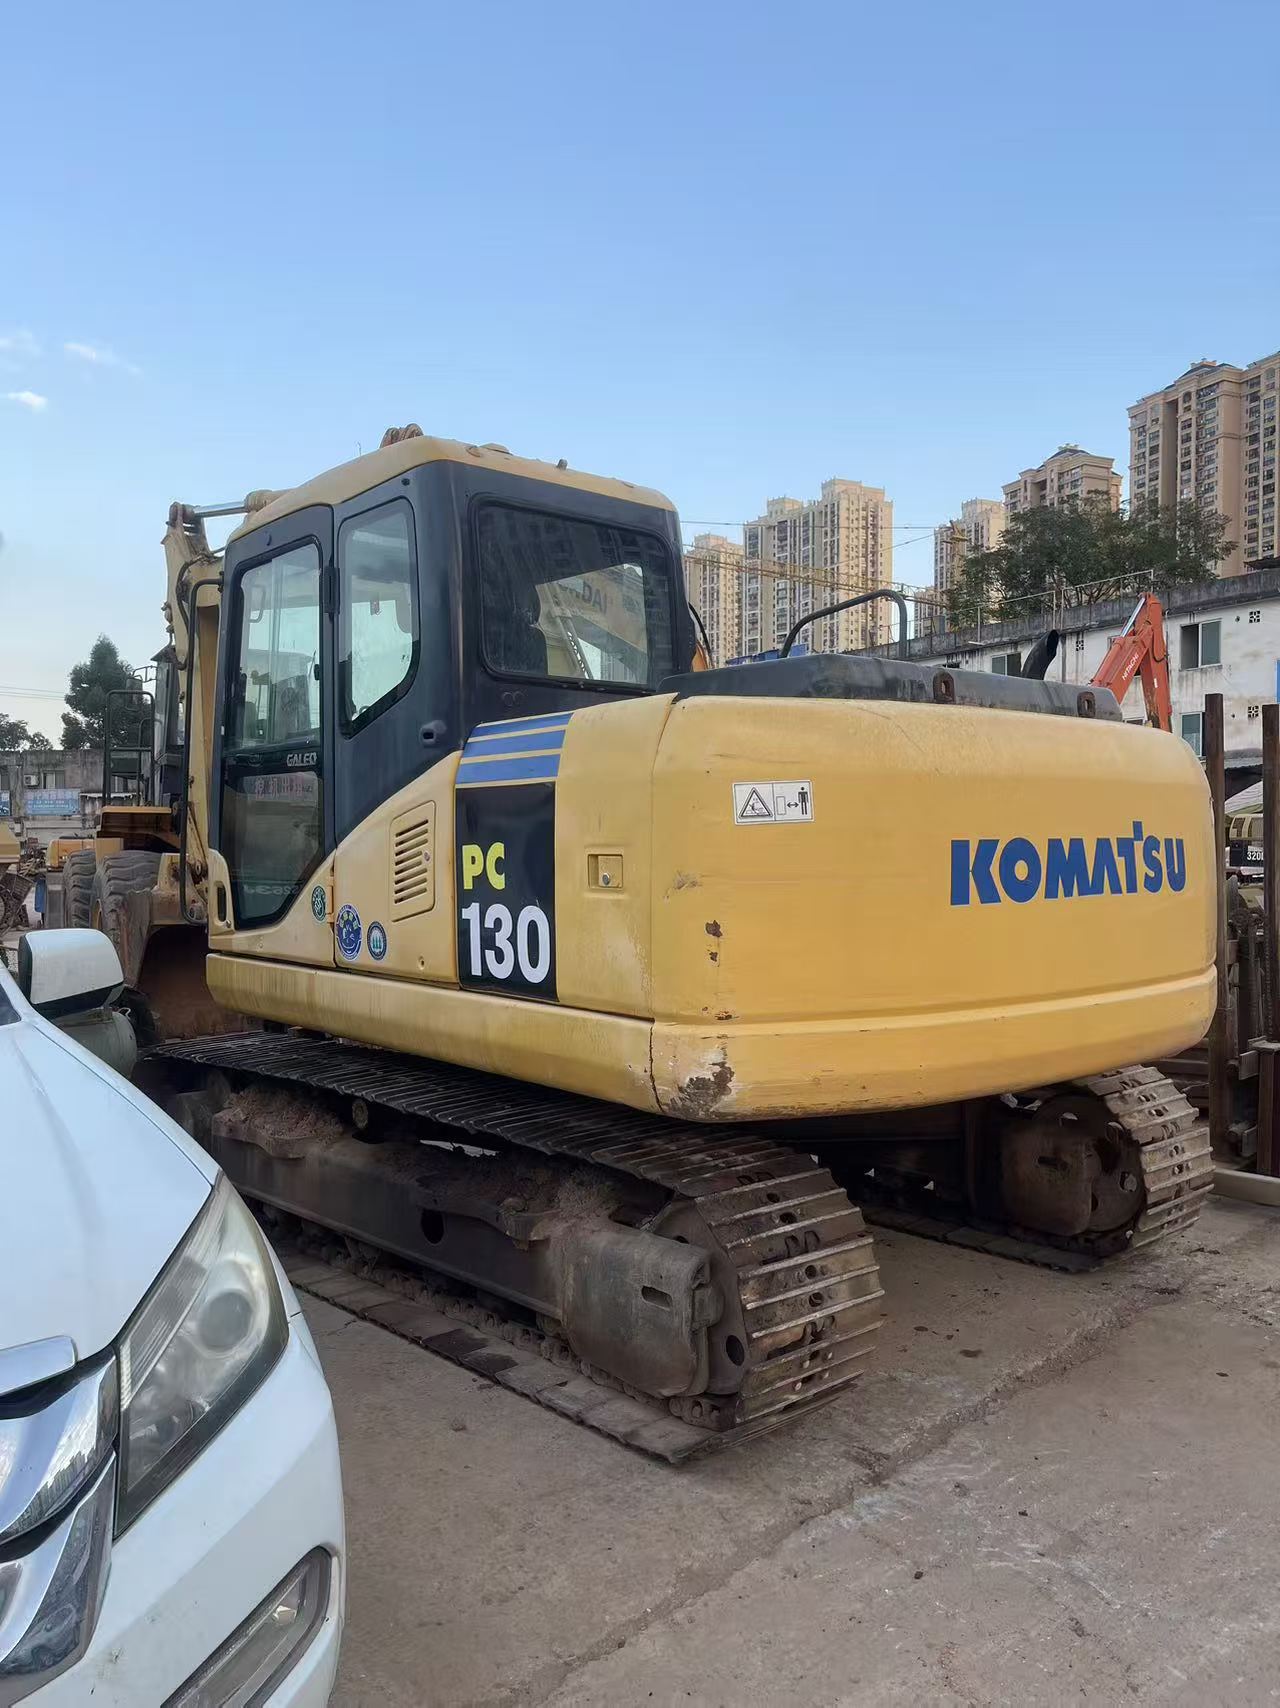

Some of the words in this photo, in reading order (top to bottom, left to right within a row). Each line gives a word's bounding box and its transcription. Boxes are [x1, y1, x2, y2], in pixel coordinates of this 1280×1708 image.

[1121, 652, 1140, 681] HITACHI
[286, 752, 318, 767] GALEO
[462, 841, 506, 890] PC
[950, 820, 1186, 906] KOMATSU
[461, 902, 551, 984] 130
